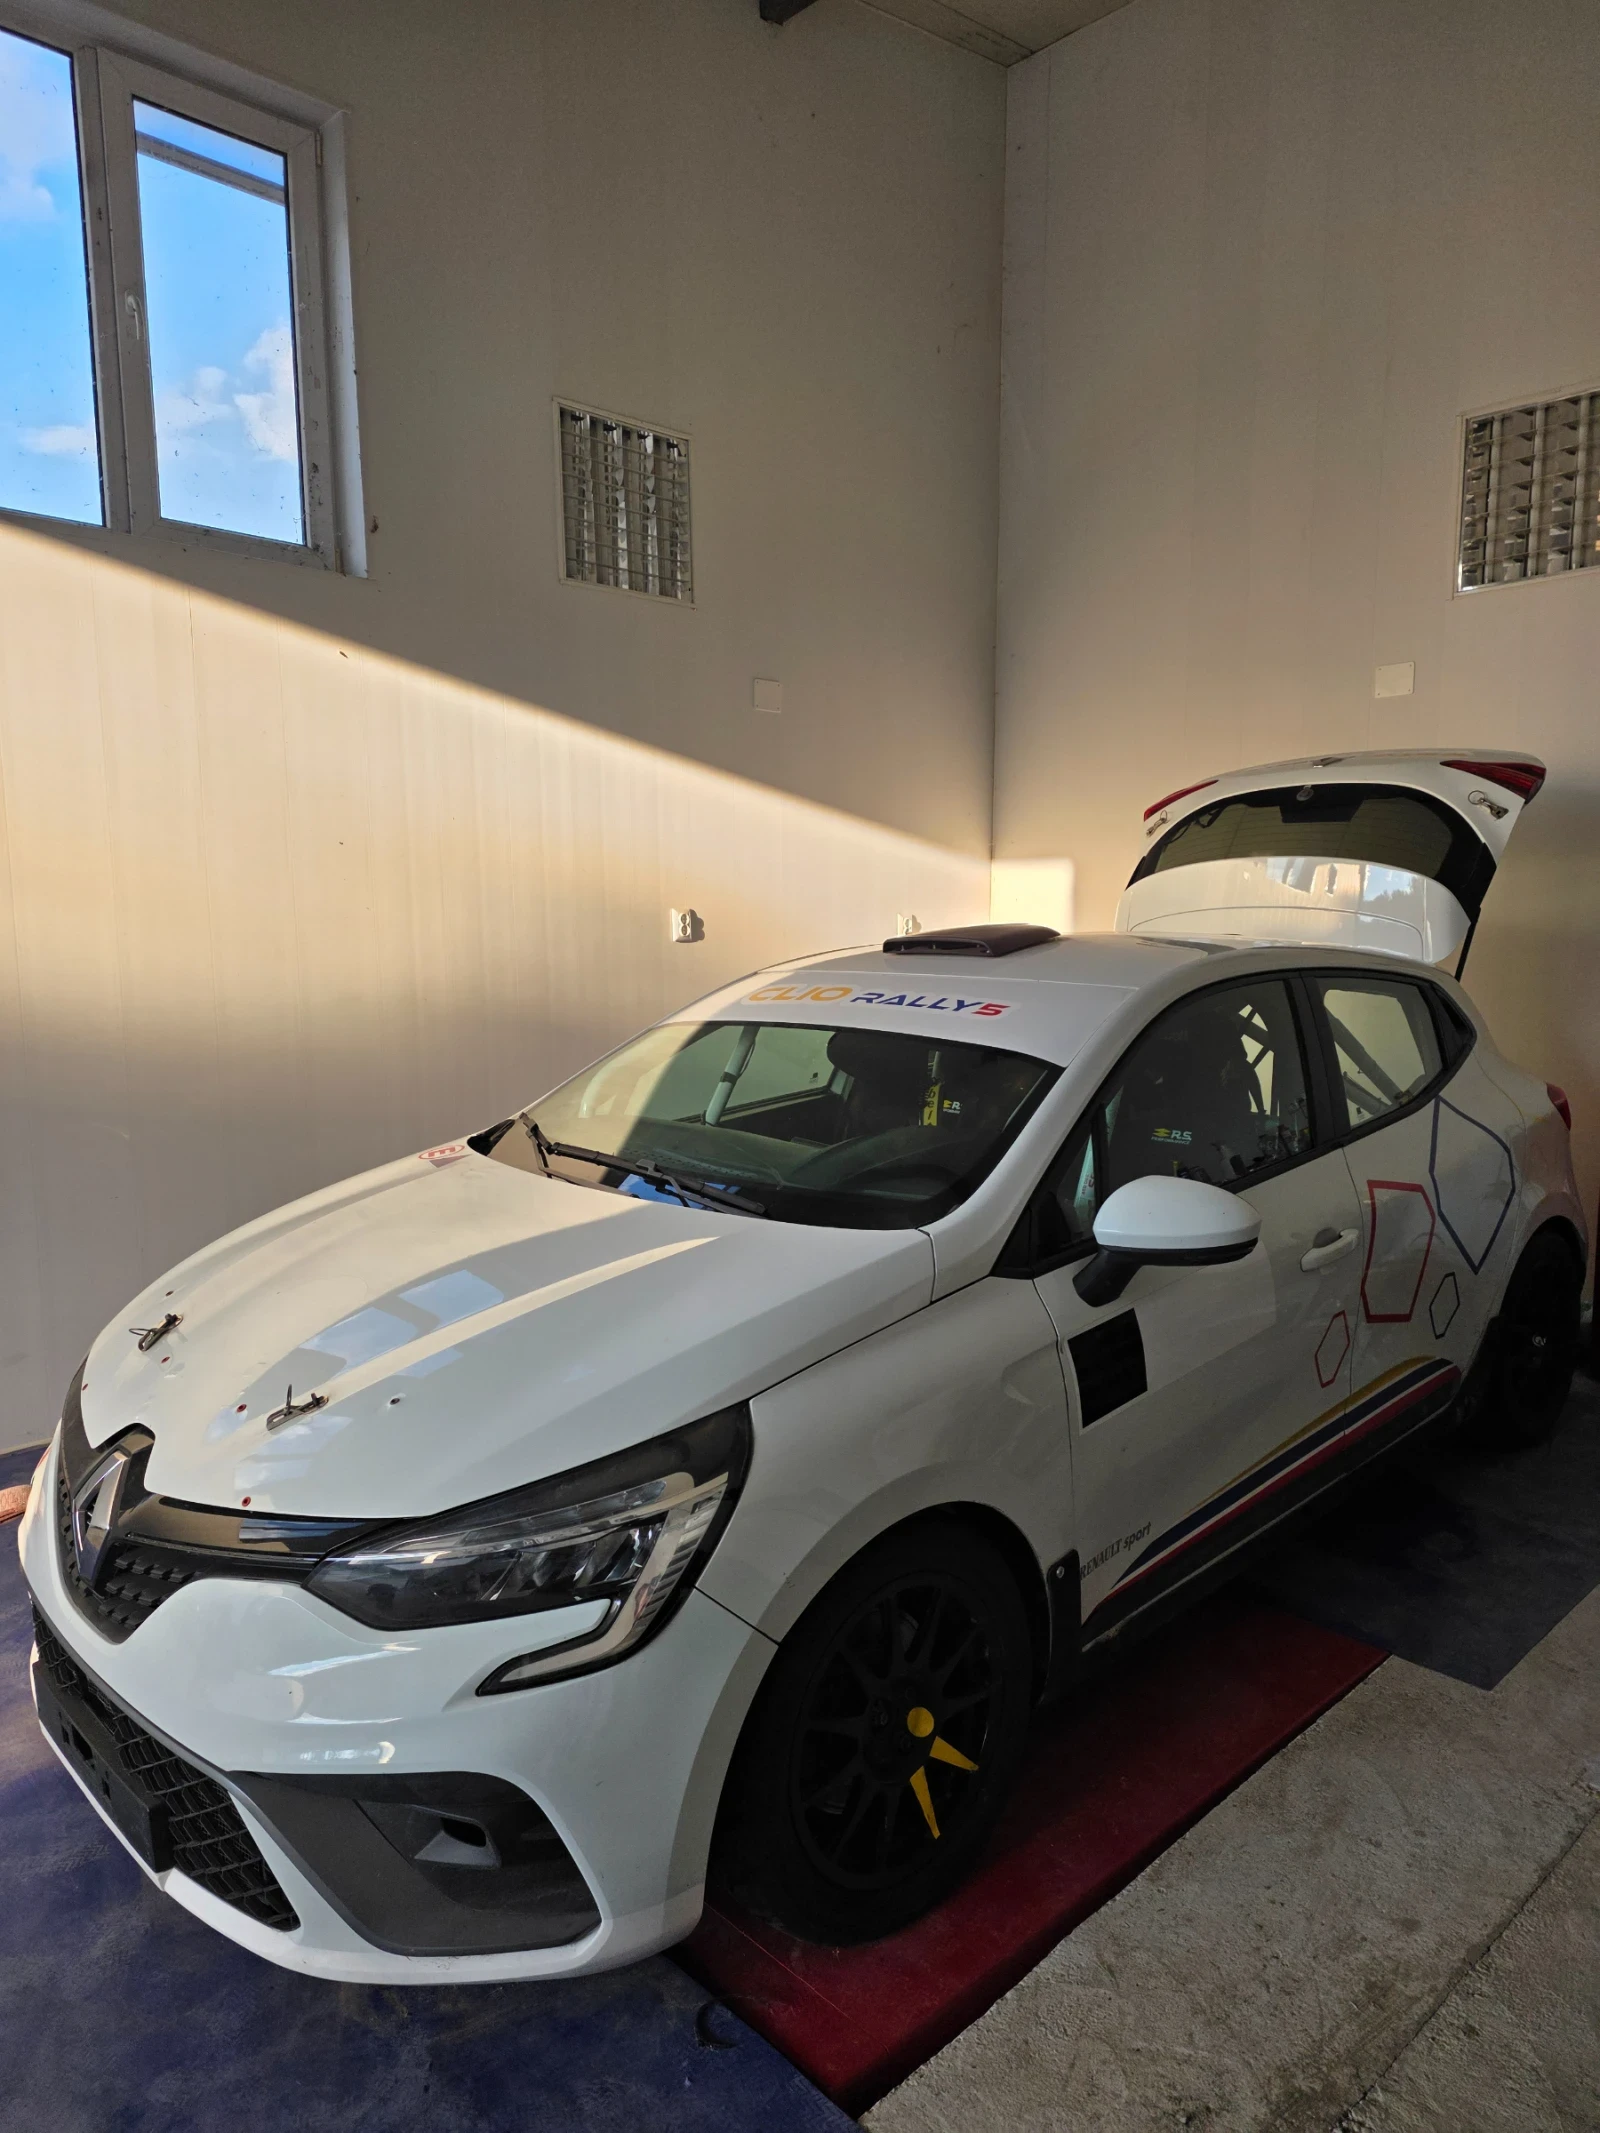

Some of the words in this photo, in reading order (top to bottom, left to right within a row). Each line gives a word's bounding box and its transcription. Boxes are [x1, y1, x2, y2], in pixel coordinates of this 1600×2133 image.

[748, 986, 853, 1002] CLIO
[1080, 1538, 1123, 1580] RENAULT
[1123, 1521, 1152, 1552] sport
